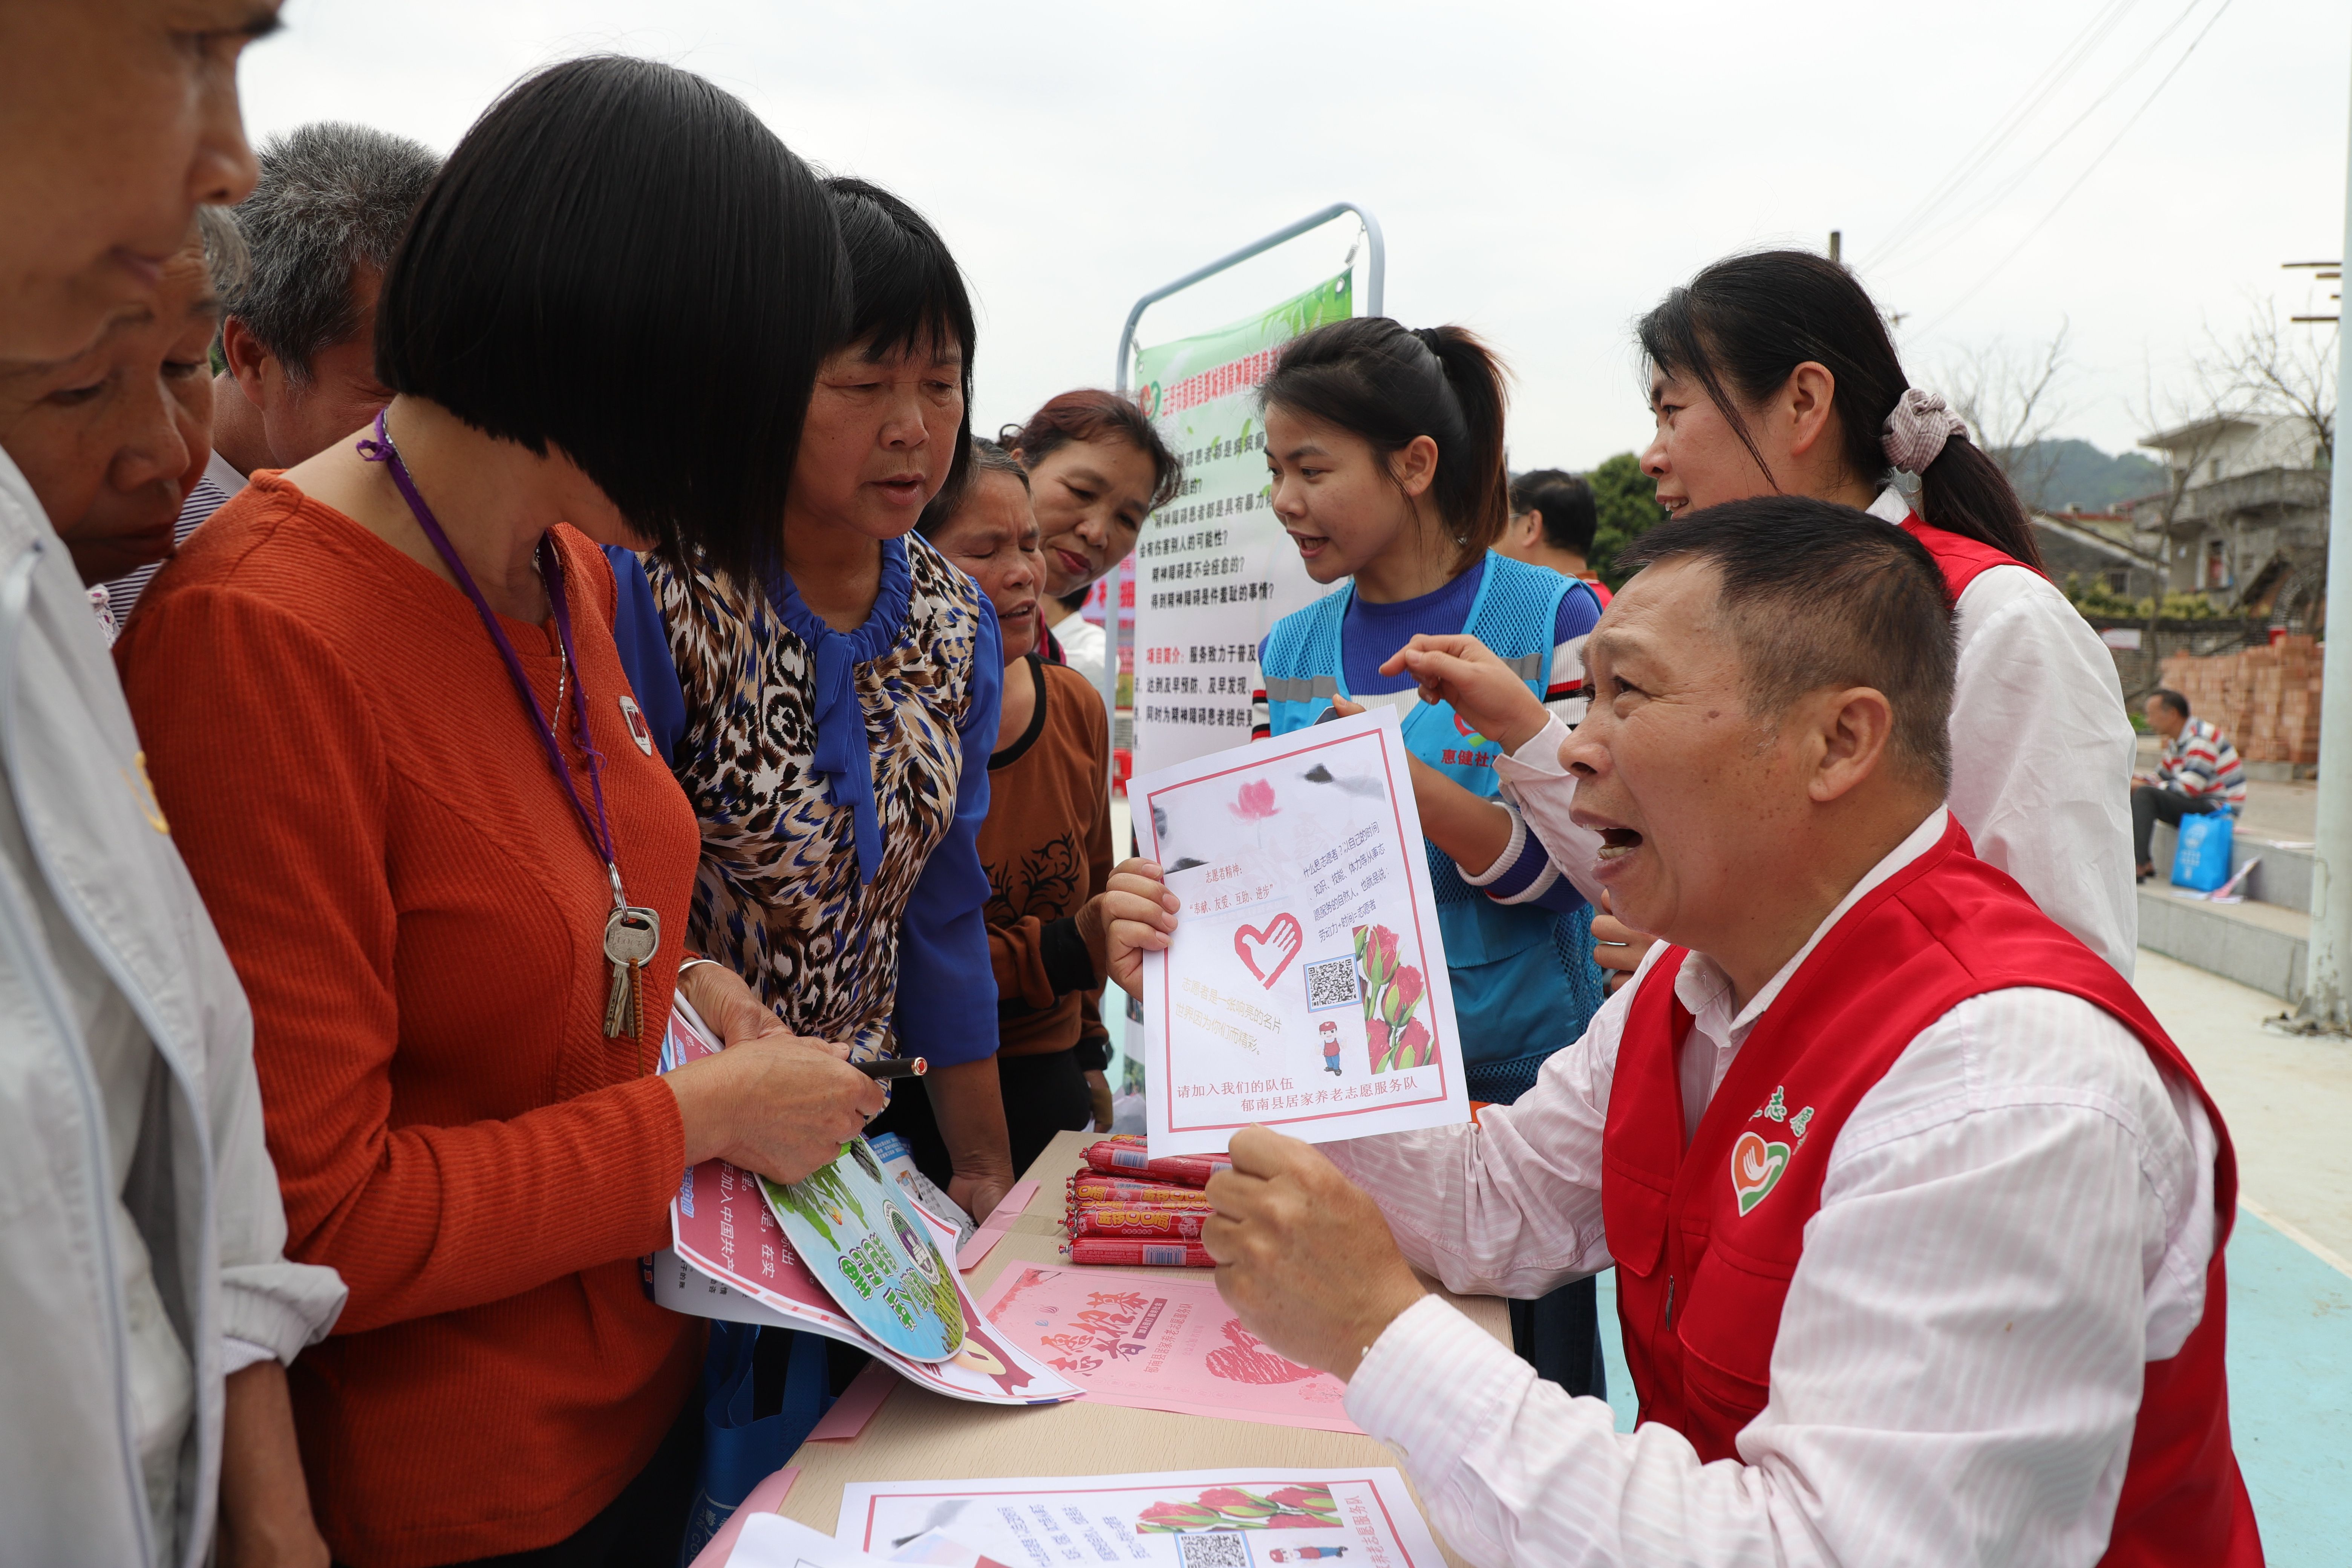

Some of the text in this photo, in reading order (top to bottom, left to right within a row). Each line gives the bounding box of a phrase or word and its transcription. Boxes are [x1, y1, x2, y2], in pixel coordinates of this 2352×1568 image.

[1205, 862, 1243, 884] 志愿者精神：
[1175, 1001, 1262, 1056] 世界因为你们而精彩。
[1181, 976, 1283, 1035] 志愿者是一张响亮的名片
[1176, 1077, 1294, 1099] 请加入我们的队伍
[1240, 1075, 1419, 1113] 郁南县居家养老志愿服务队
[1756, 1085, 1815, 1147] 志愿
[679, 1260, 688, 1289] 子的账
[1143, 1303, 1194, 1373] 郁南县居家养老志愿服务队
